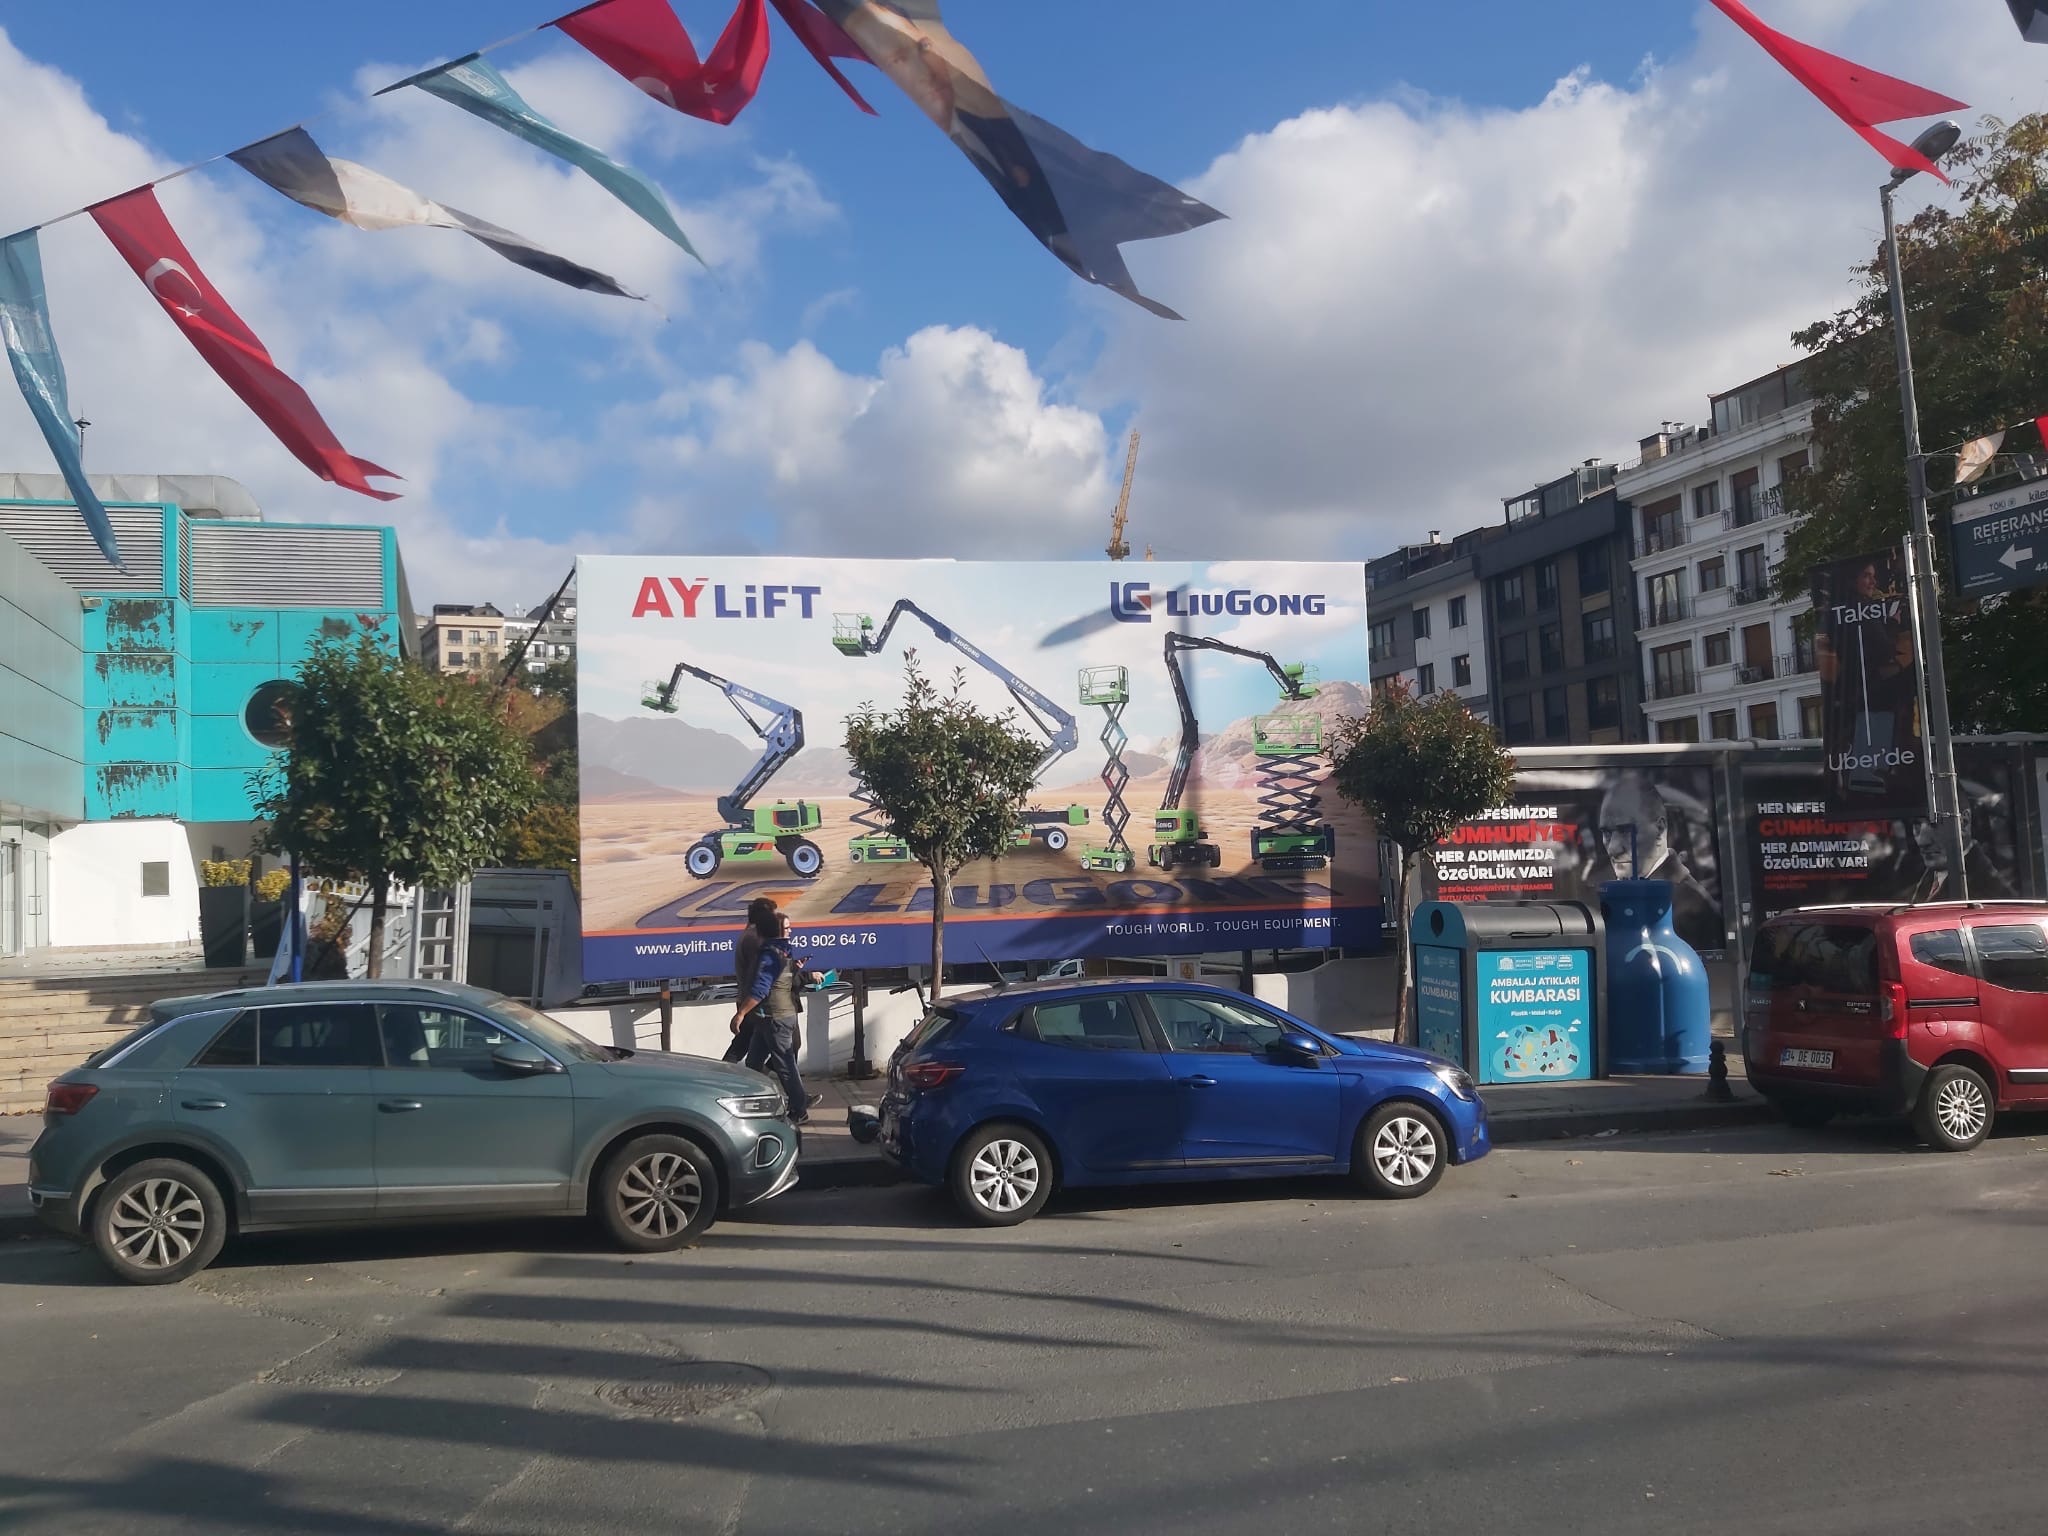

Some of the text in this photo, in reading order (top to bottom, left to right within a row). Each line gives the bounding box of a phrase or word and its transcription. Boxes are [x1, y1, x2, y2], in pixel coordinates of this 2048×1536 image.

[1832, 599, 1887, 625] Taksi
[1828, 747, 1916, 771] Uber'de
[1757, 803, 1784, 814] HER
[1760, 840, 1870, 854] HER ADIMIMIZDA
[1435, 848, 1556, 863] HER ADIMIMIZDA
[1763, 854, 1868, 870] ÖZGÜRLÜK VAR!
[1437, 864, 1554, 881] ÖZGÜRLÜK VAR!
[1106, 917, 1341, 936] TOUGH WORLD. TOUGH EQUIPMENT.
[635, 939, 733, 956] www.aylift.net
[811, 934, 836, 947] 902
[840, 933, 857, 946] 64
[860, 932, 877, 945] 76
[1490, 976, 1580, 987] AMBALAJ ATIKLARI
[1490, 988, 1581, 1004] KUMBARASI
